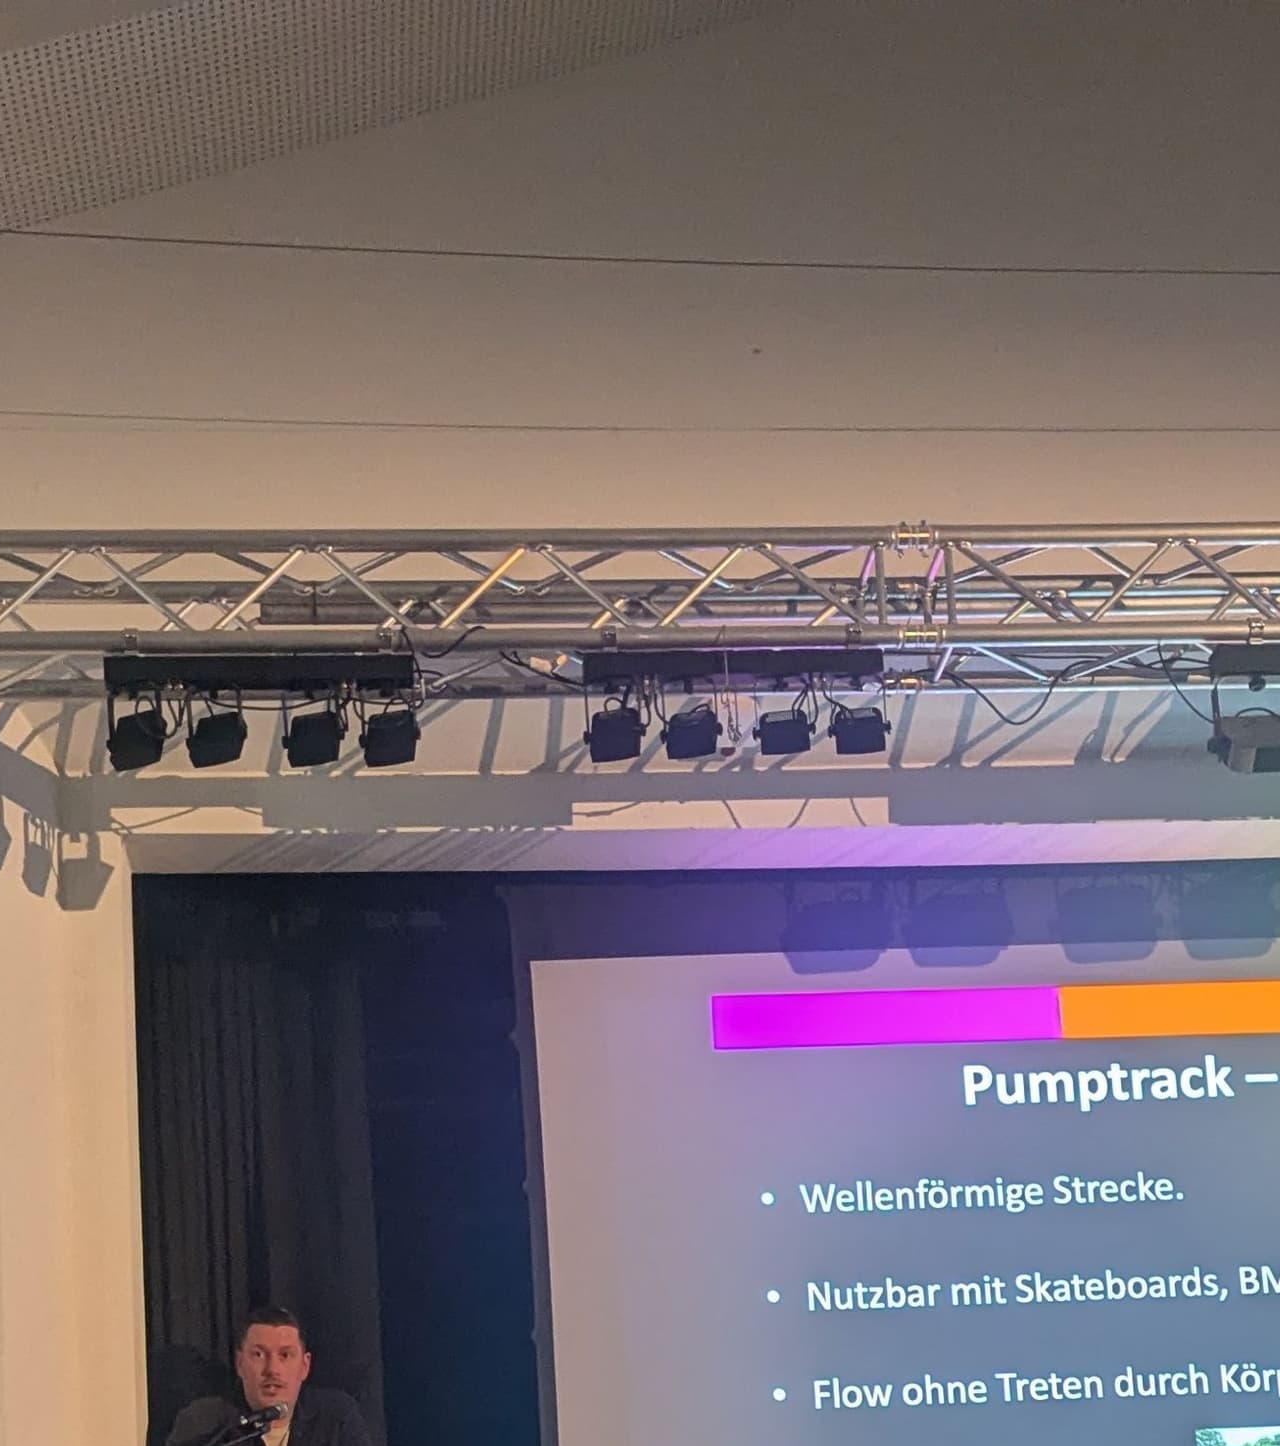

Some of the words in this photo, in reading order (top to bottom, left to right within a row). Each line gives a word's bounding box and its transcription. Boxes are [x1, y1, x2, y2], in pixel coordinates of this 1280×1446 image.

[962, 1054, 1235, 1112] Pumptrack
[799, 1177, 1044, 1213] Wellenförmige
[1052, 1171, 1184, 1205] Strecke.
[807, 1277, 941, 1312] Nutzbar
[950, 1274, 1007, 1306] mit
[1015, 1266, 1228, 1304] Skateboards,
[813, 1377, 893, 1410] Flow
[902, 1373, 988, 1406] ohne
[994, 1372, 1104, 1402] Treten
[1114, 1363, 1210, 1398] durch
